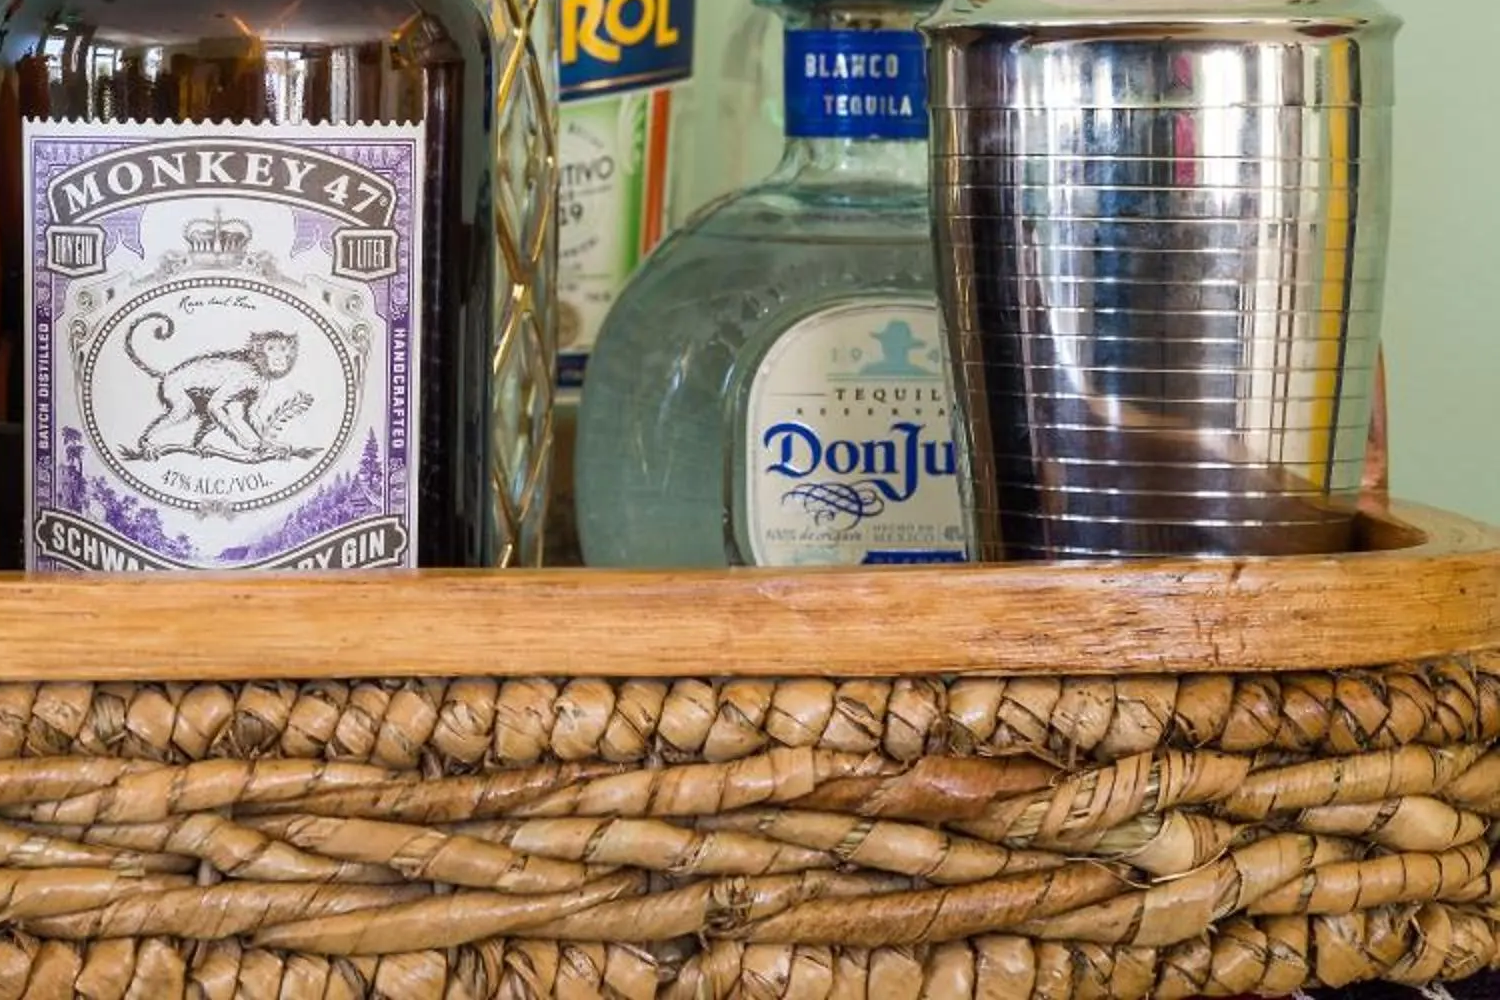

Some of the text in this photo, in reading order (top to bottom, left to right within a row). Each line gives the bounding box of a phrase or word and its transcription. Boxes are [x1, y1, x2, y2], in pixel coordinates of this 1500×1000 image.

[804, 53, 899, 79] BLANCO
[823, 94, 913, 117] TEQUILA
[61, 151, 383, 215] MONKEY 47
[357, 239, 385, 269] LITER
[38, 323, 50, 449] BATCH DISTILLED
[391, 327, 406, 449] HANDCRAFTED
[834, 387, 942, 403] TEQUIL
[341, 528, 386, 569] GIN
